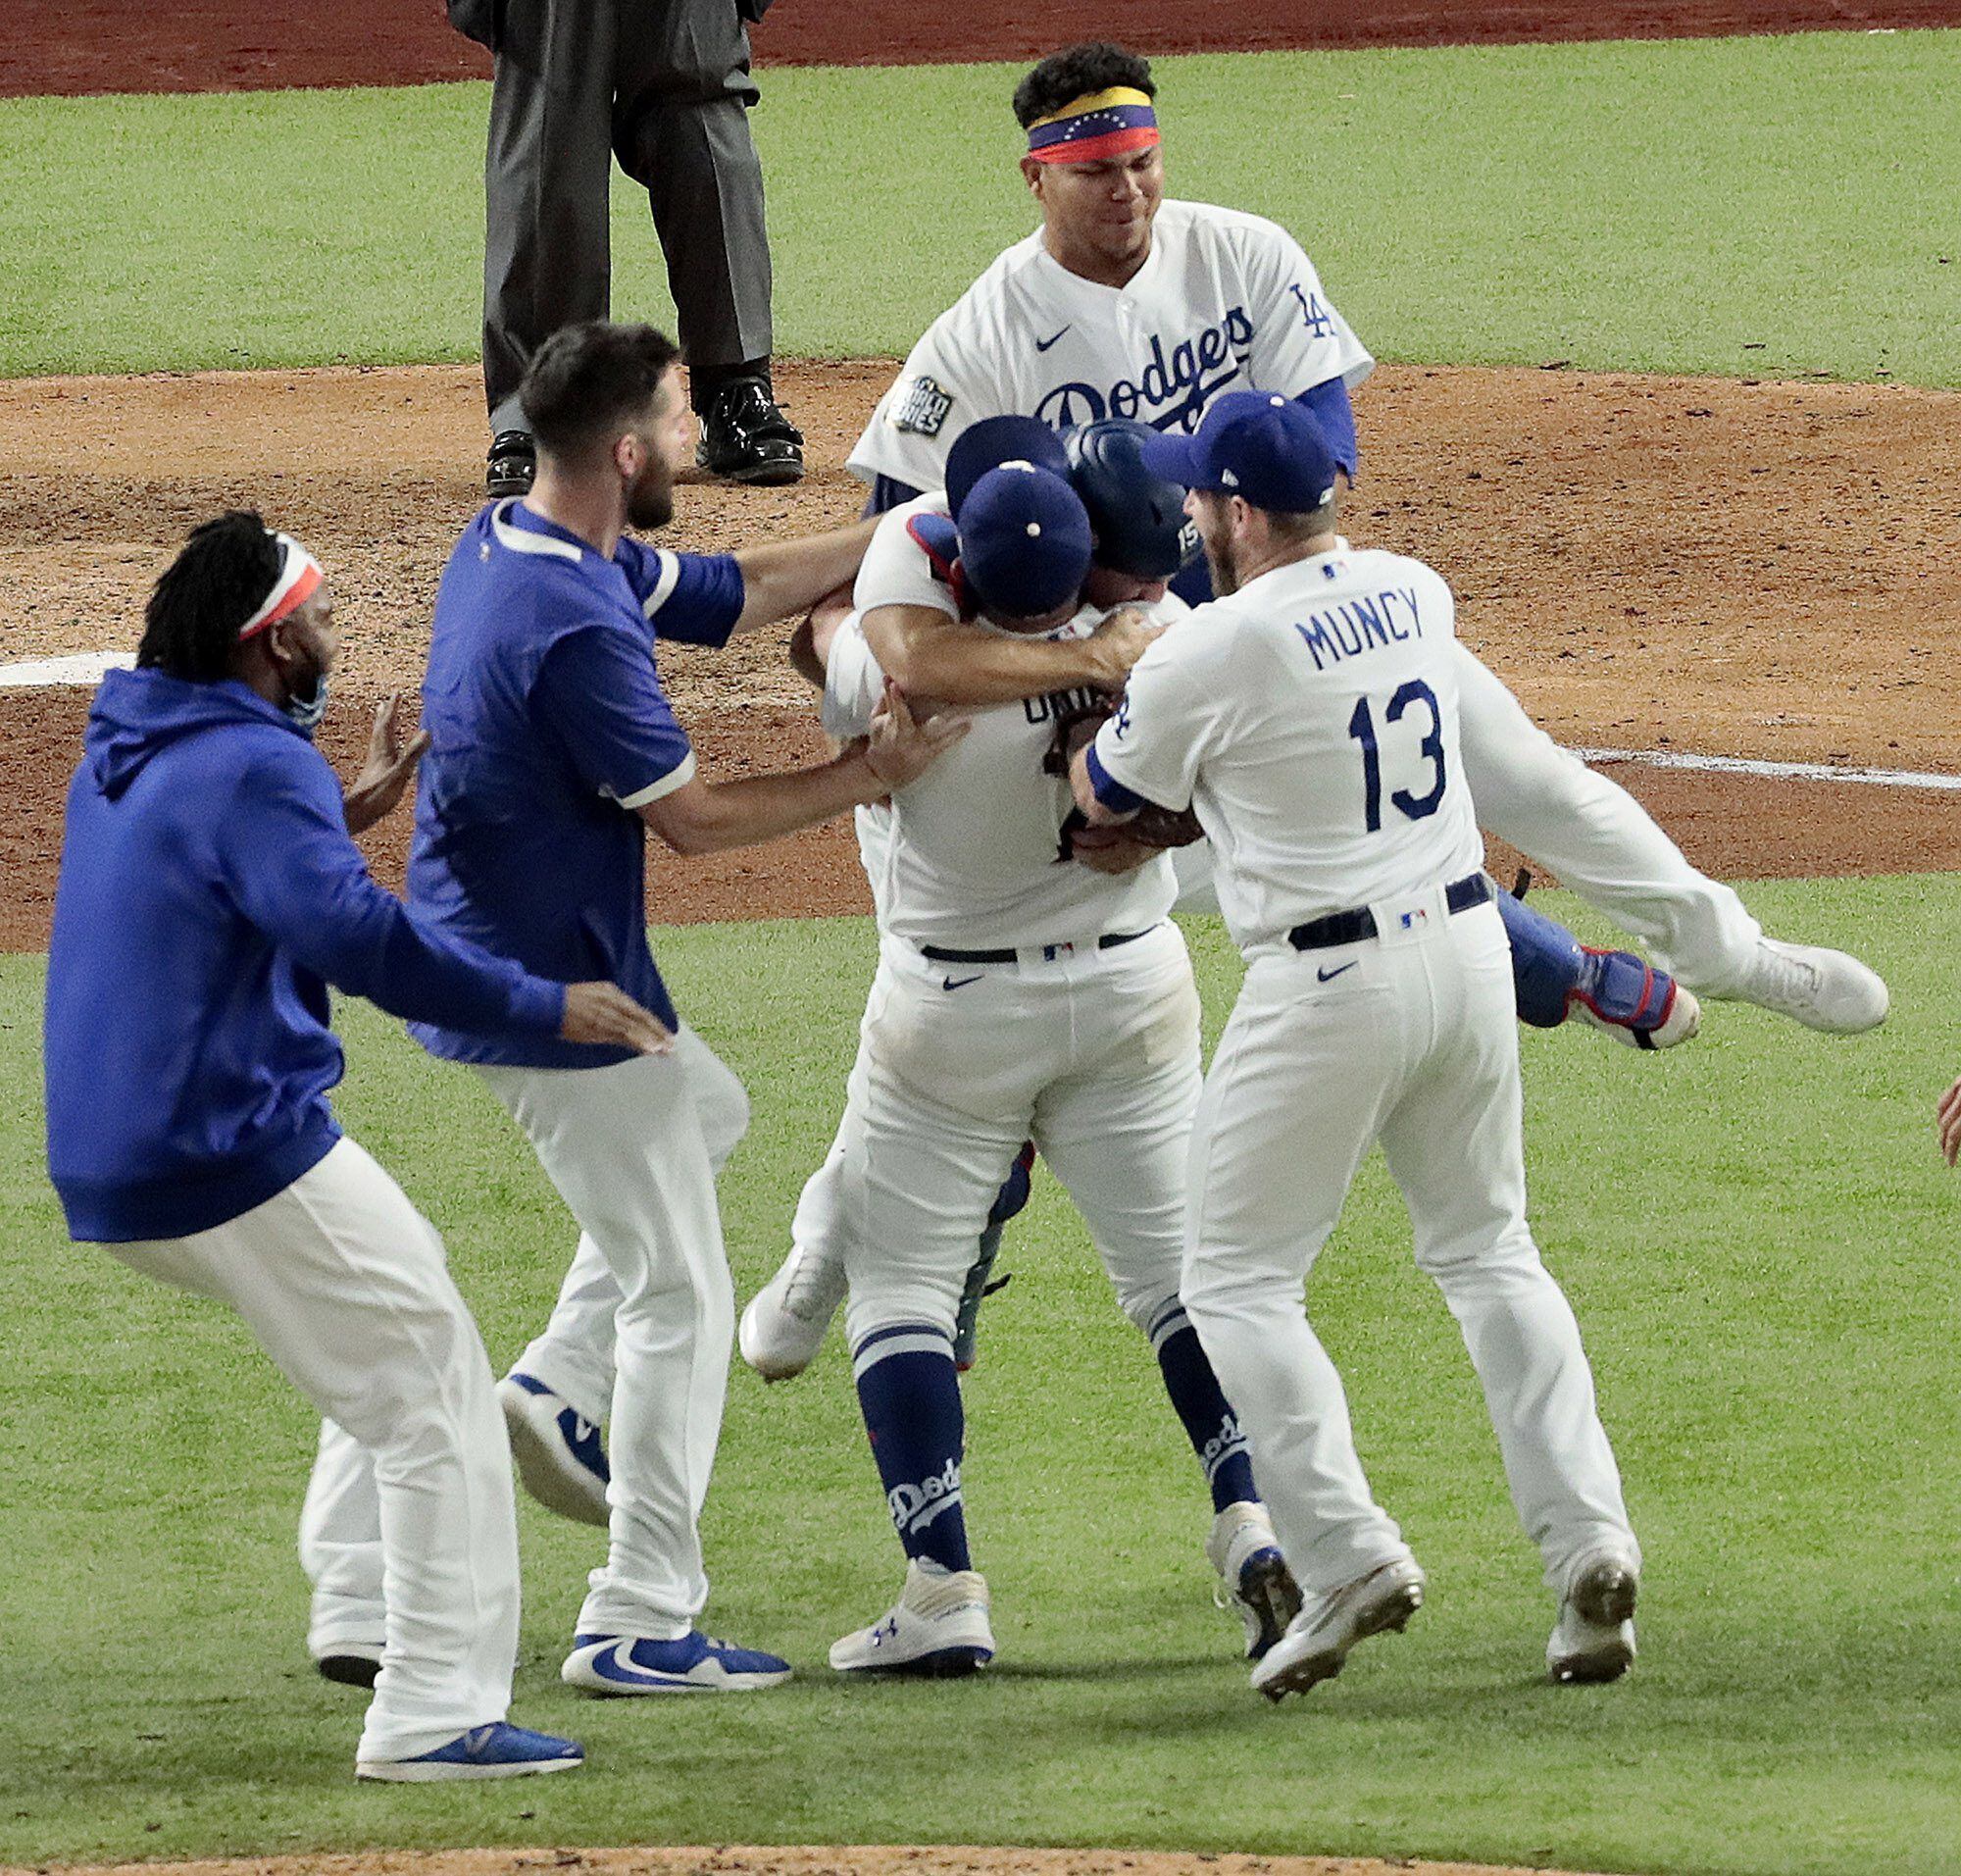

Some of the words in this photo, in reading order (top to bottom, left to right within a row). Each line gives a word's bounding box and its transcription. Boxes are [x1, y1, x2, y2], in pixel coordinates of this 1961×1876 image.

[1034, 307, 1253, 434] Dodges
[1178, 519, 1198, 552] 15
[1294, 587, 1422, 671] MUNCY
[1348, 679, 1446, 833] 13
